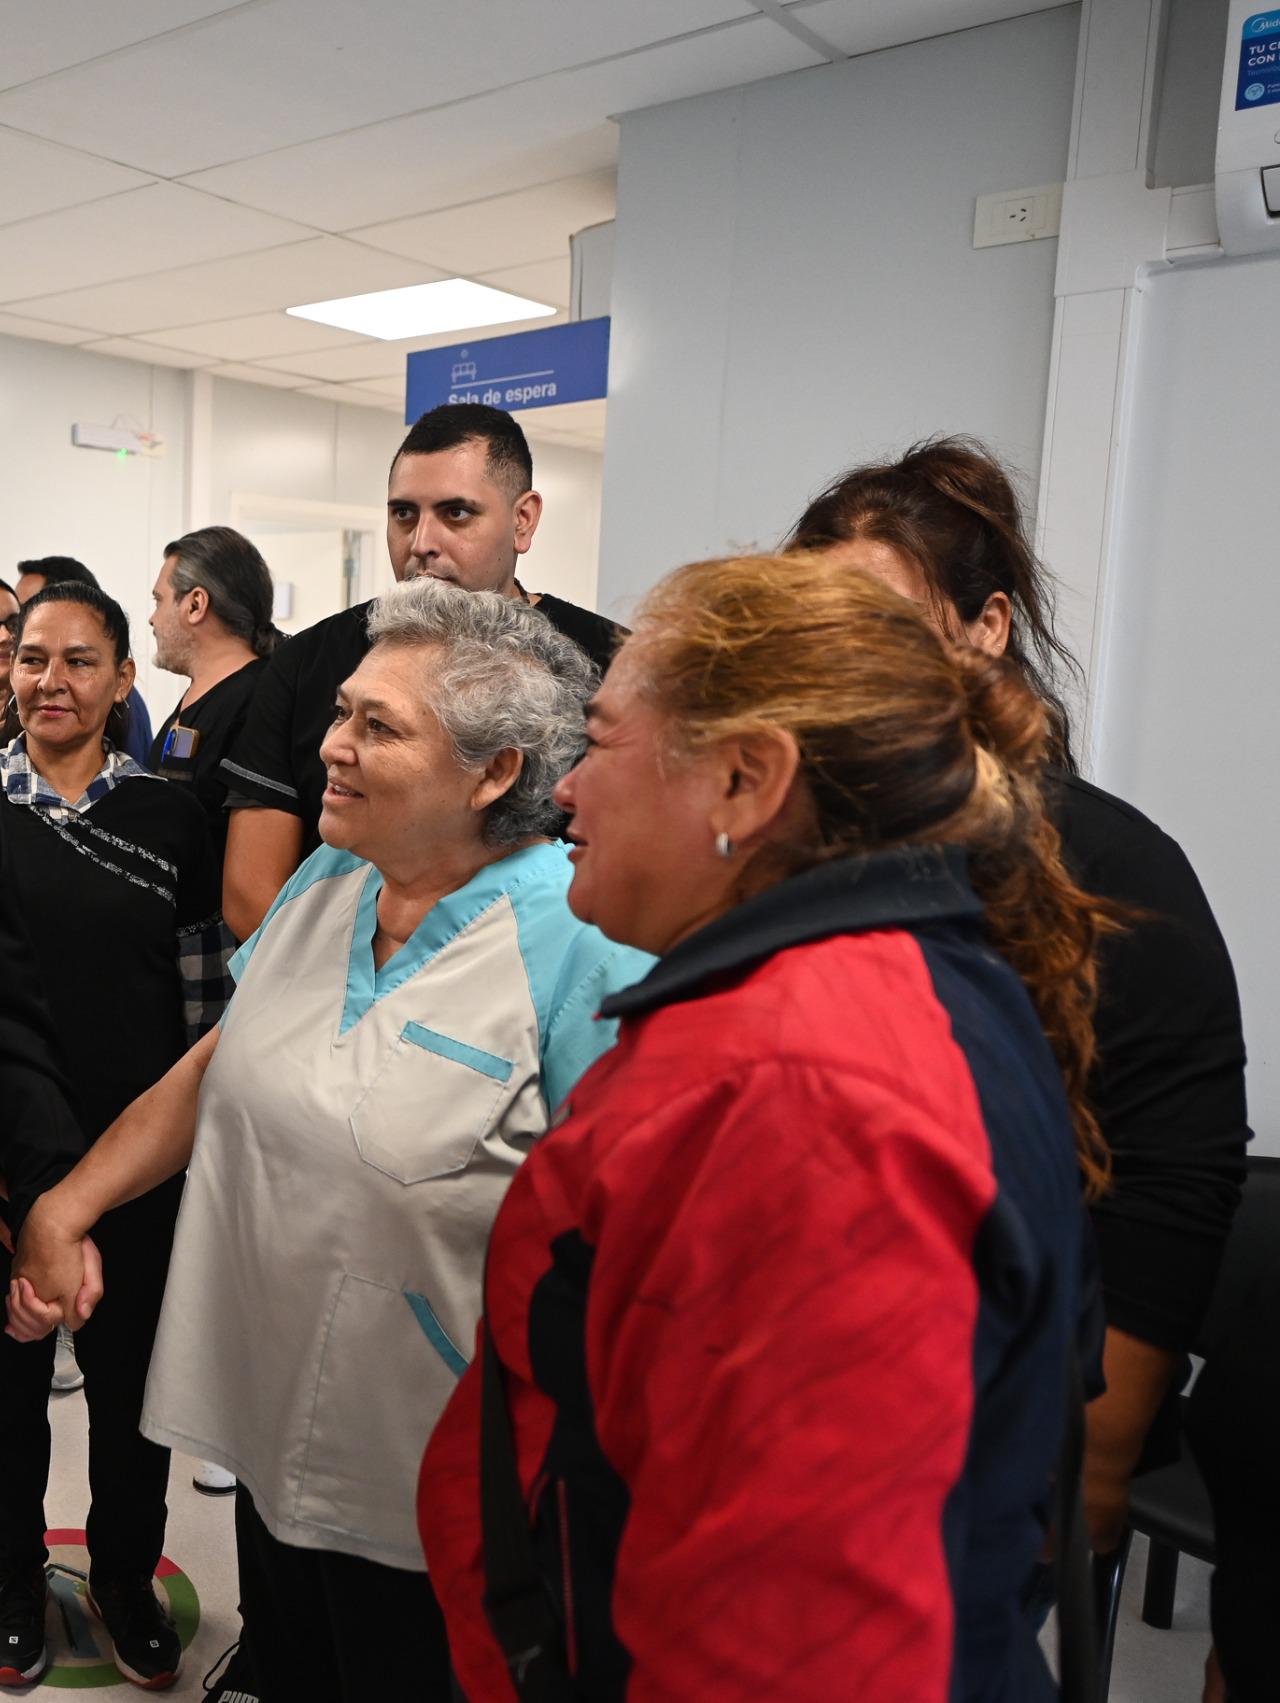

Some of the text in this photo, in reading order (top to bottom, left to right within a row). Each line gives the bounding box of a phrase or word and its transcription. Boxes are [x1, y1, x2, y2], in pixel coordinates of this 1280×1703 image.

[1249, 44, 1266, 55] TU
[1248, 53, 1276, 66] CON
[483, 388, 502, 405] de
[505, 382, 557, 405] espera
